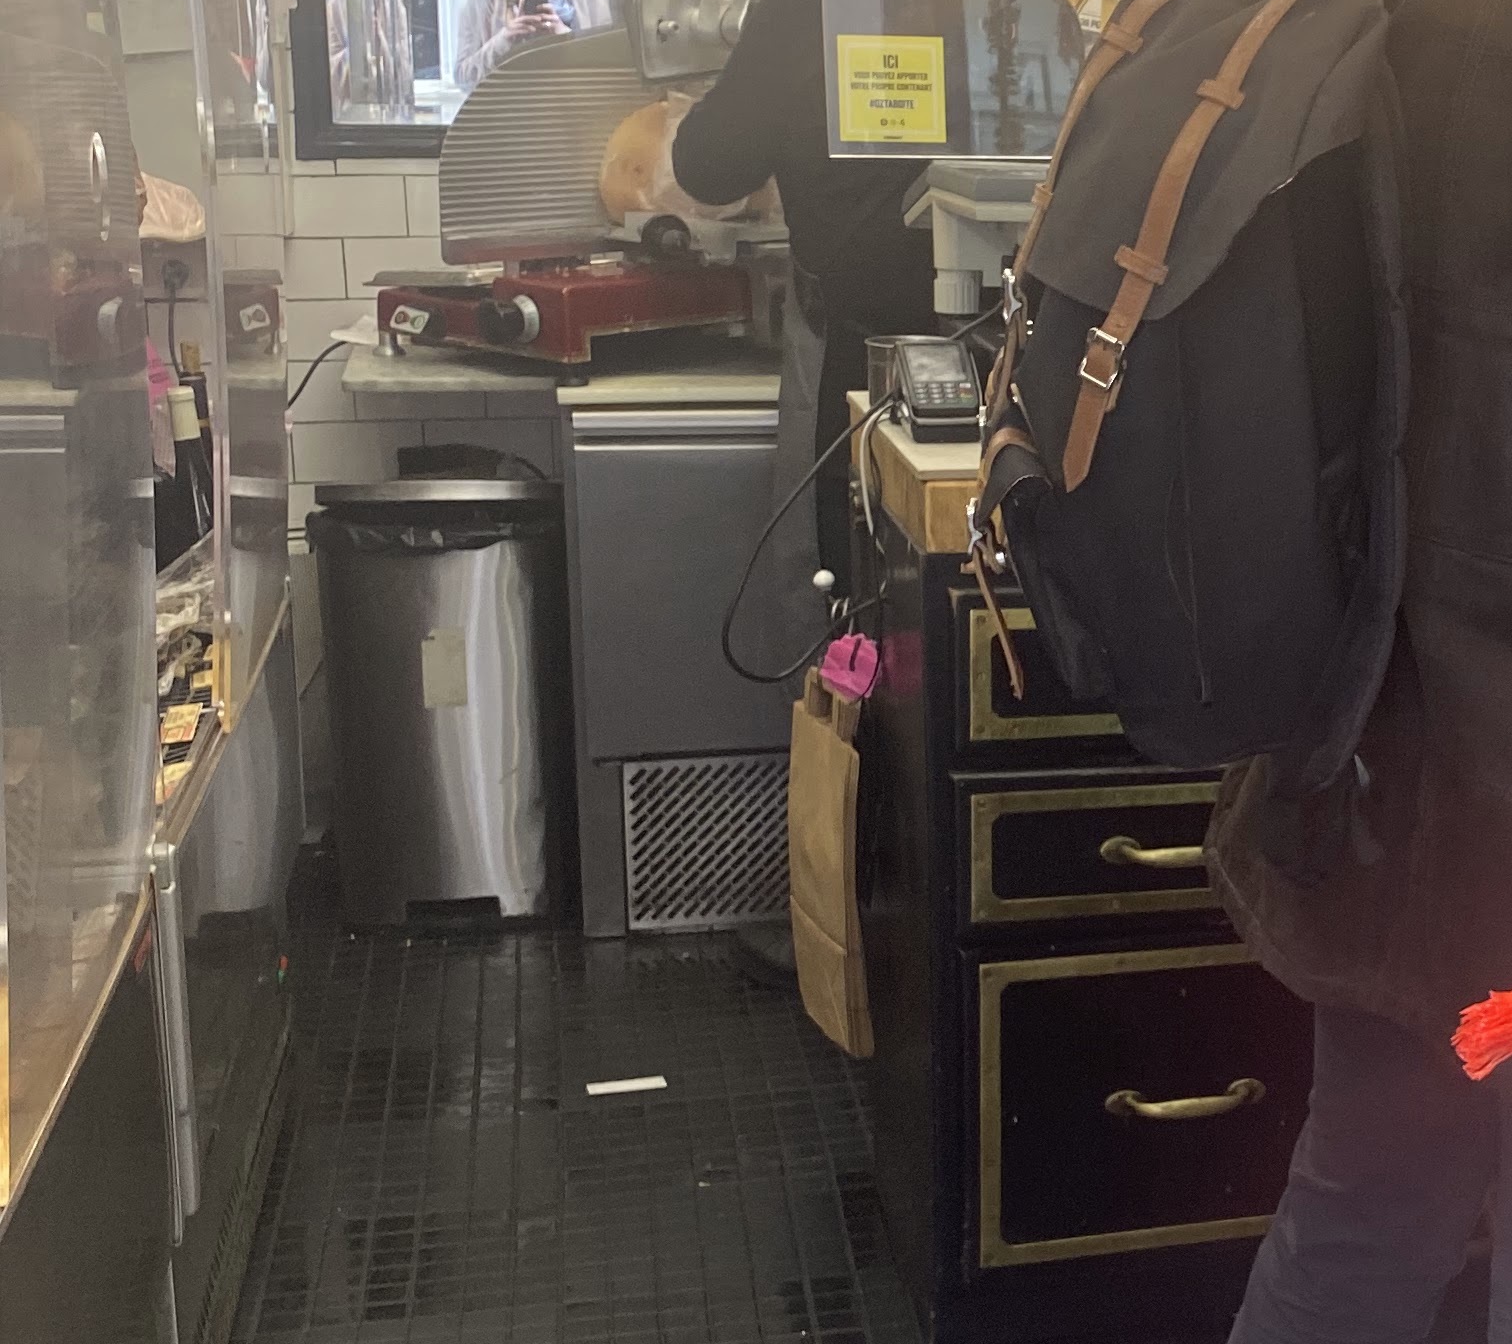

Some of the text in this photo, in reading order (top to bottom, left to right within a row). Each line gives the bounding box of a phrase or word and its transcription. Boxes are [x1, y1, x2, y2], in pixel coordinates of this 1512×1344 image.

[882, 54, 899, 69] ICI
[871, 71, 895, 80] POUVEZ
[896, 72, 928, 81] APPORTER
